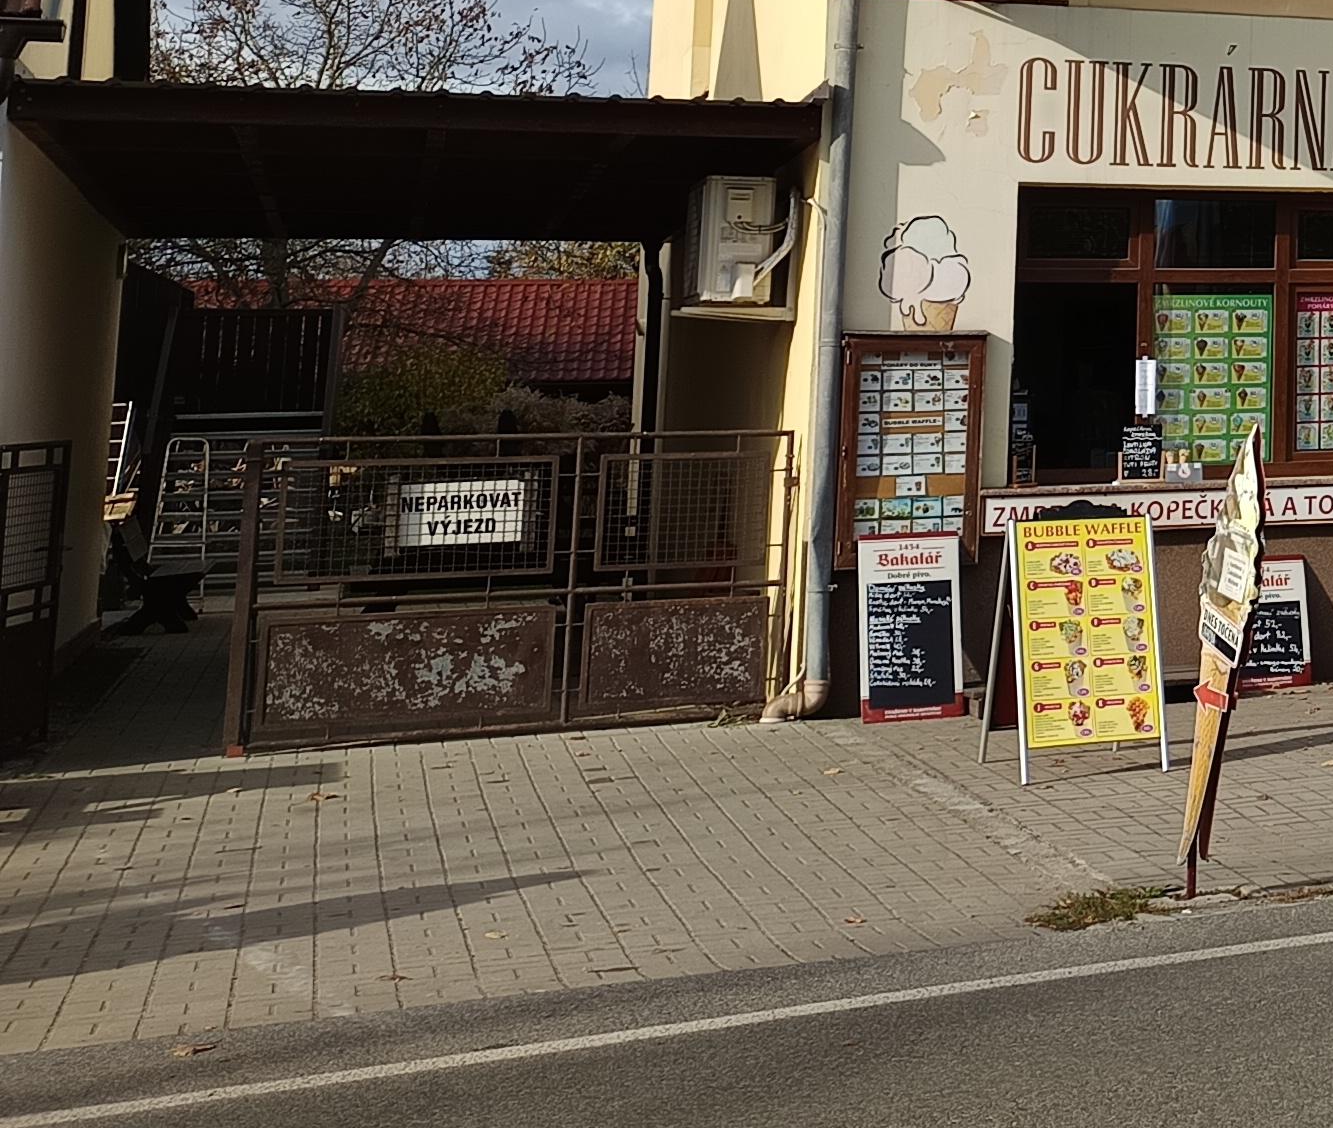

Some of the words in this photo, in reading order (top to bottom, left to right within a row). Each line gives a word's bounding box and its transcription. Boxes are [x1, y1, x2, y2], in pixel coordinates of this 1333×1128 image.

[1216, 298, 1268, 308] KORNOUTY
[402, 492, 522, 512] NEPARKOVAT
[1131, 492, 1274, 521] KOPEČKÁ
[1282, 496, 1297, 516] A
[427, 515, 496, 536] VÝJEZD
[1024, 524, 1080, 538] BUBBLE
[1084, 522, 1142, 535] WAFFLE
[877, 551, 942, 566] Bakalář
[888, 572, 910, 580] Dobré
[1262, 574, 1290, 588] alář
[1204, 609, 1218, 629] DNES
